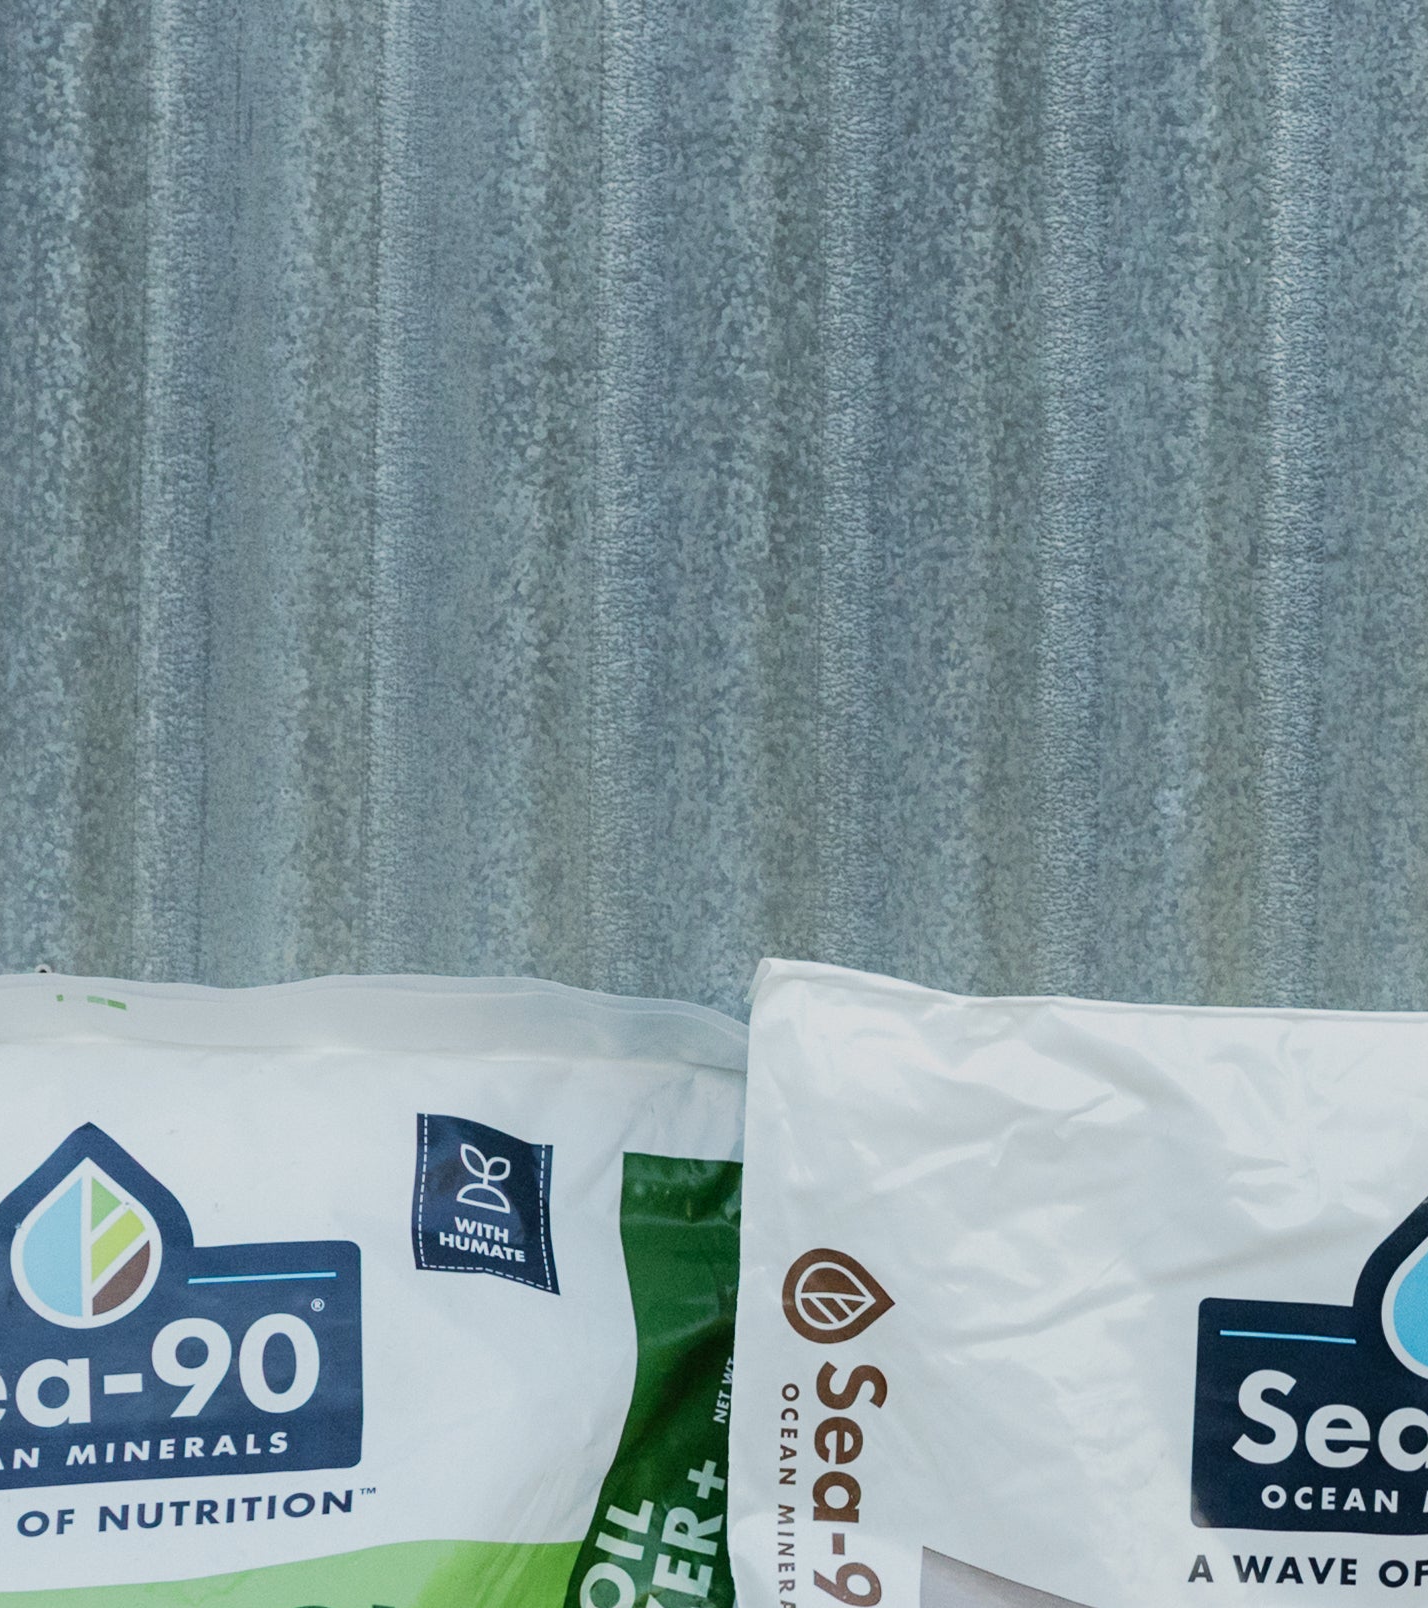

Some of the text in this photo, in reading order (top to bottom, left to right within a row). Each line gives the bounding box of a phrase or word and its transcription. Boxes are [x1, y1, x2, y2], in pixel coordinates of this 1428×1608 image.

[454, 1216, 509, 1244] WITH
[439, 1232, 526, 1262] HUMATE
[713, 1389, 730, 1424] NET
[66, 1431, 288, 1466] MINERALS
[779, 1382, 800, 1487] OCEAN
[1261, 1484, 1398, 1514] OCEAN
[17, 1508, 75, 1537] OF
[1188, 1554, 1214, 1582] A
[1233, 1554, 1357, 1585] WAVE
